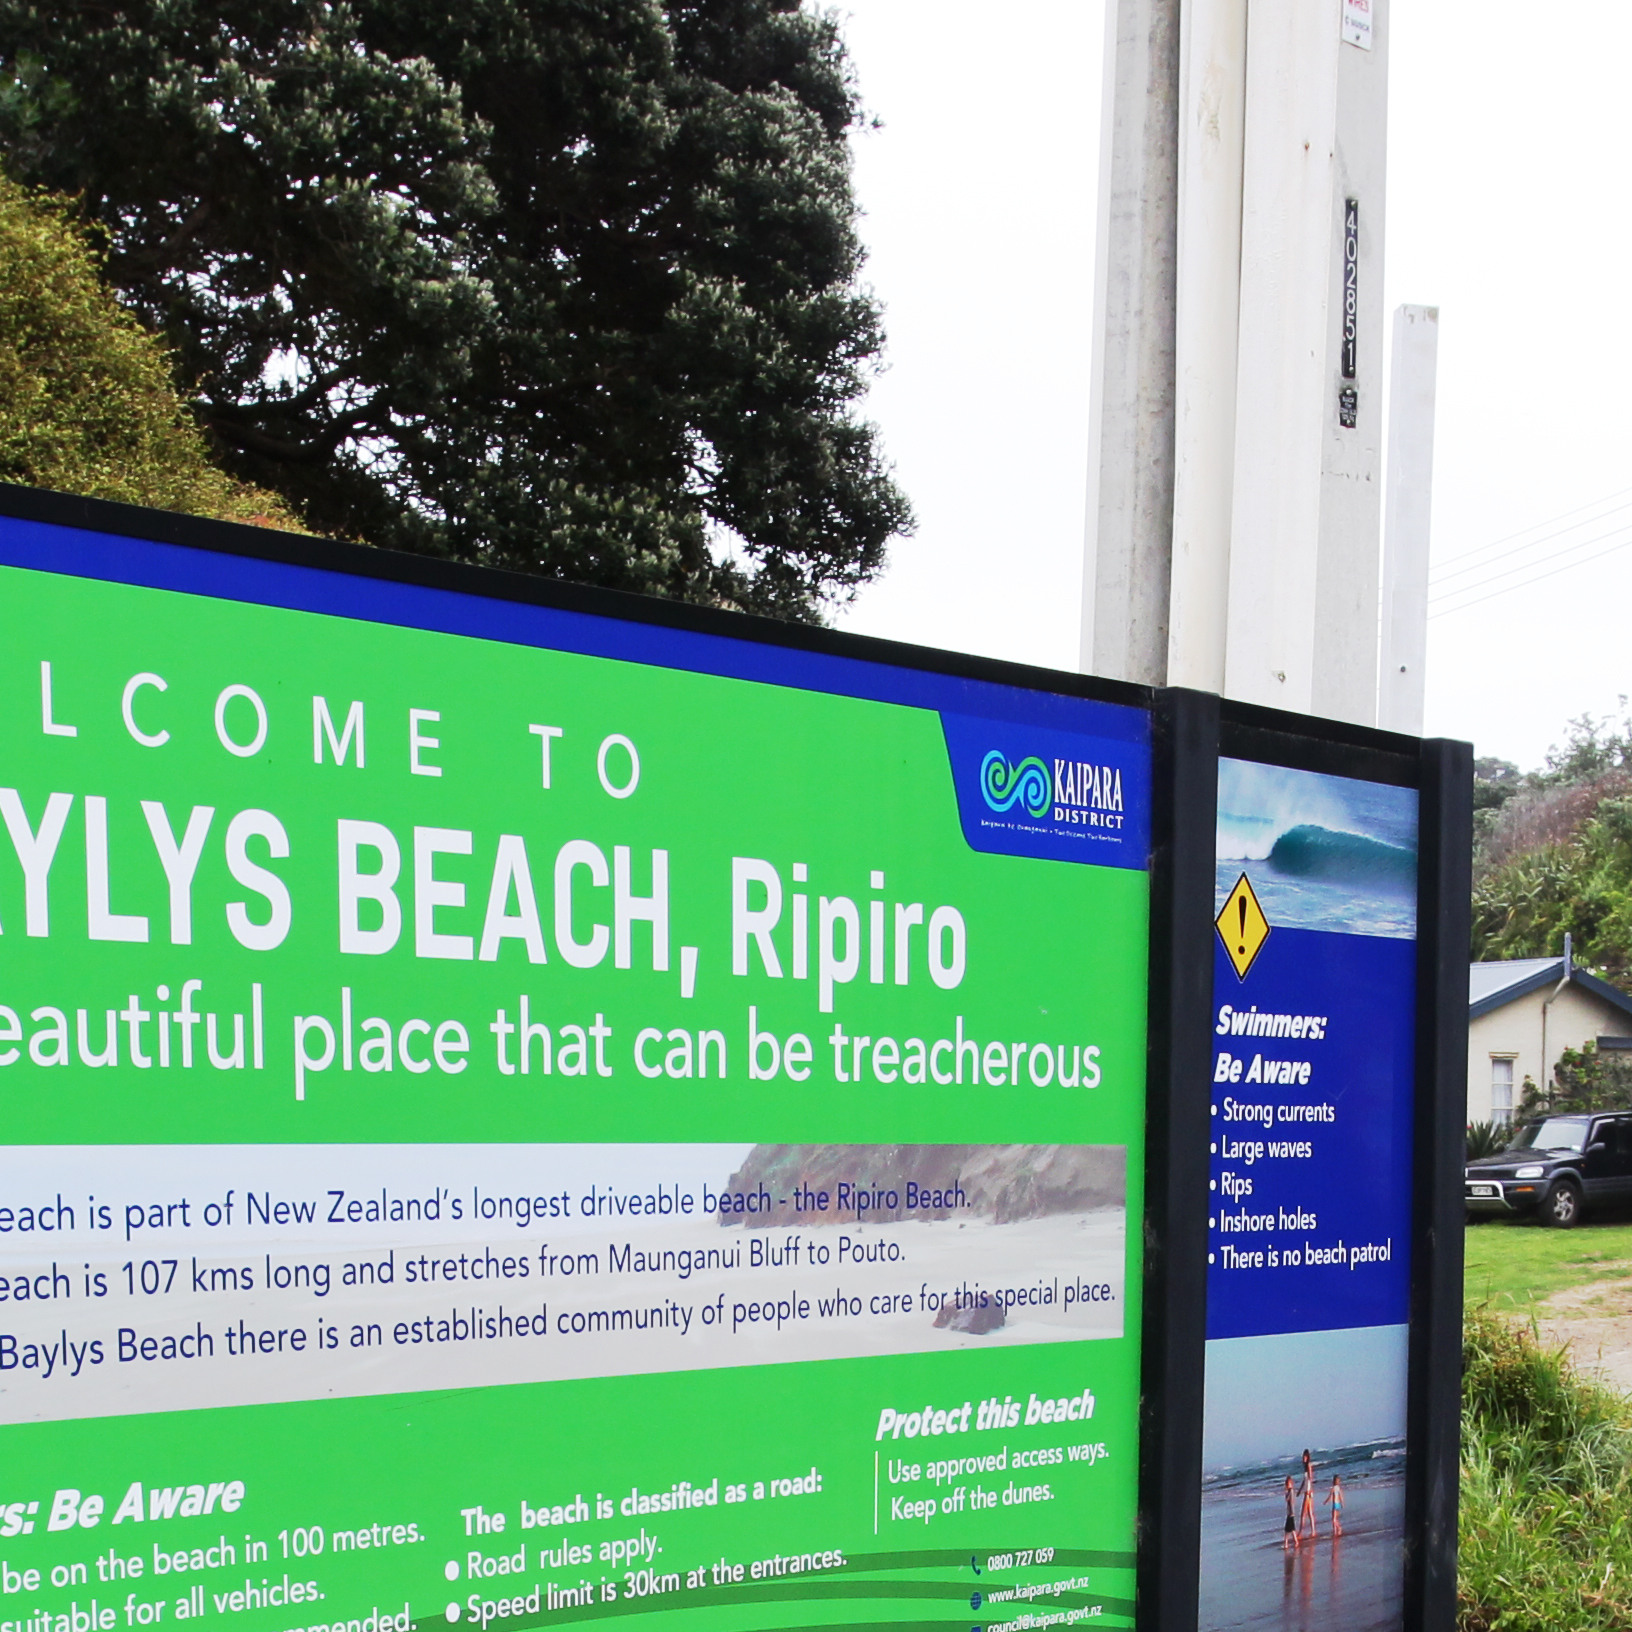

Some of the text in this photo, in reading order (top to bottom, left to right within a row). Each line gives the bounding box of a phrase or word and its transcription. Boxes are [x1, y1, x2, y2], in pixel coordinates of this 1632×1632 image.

[1345, 211, 1356, 366] 402851
[529, 724, 640, 799] TO
[1055, 759, 1122, 811] KAIPARA
[1055, 808, 1123, 831] DISTRICT
[338, 819, 698, 998] BEACH,
[732, 857, 966, 1013] Ripiro
[294, 987, 469, 1100] place
[490, 995, 612, 1077] that
[634, 1028, 726, 1078] can
[749, 1006, 812, 1081] be
[829, 1016, 1100, 1088] treacherous
[1216, 1005, 1327, 1039] Swimmers:
[1214, 1053, 1310, 1084] Be Aware
[1224, 1097, 1334, 1128] Strong currents
[1223, 1135, 1311, 1165] Large waves
[89, 1196, 111, 1229] is
[126, 1199, 190, 1241] part
[204, 1190, 234, 1226] of
[248, 1192, 316, 1224] New
[328, 1187, 462, 1222] Zealand's
[475, 1187, 569, 1227] longest
[581, 1184, 693, 1216] driveable
[704, 1182, 771, 1213] beach
[793, 1181, 829, 1211] the
[838, 1182, 898, 1220] Ripiro
[906, 1179, 970, 1209] Beach.
[1222, 1172, 1252, 1203] Rips
[1221, 1206, 1316, 1232] Inshore holes
[85, 1264, 107, 1296] is
[123, 1260, 177, 1294] 107
[193, 1257, 253, 1291] kms
[267, 1255, 329, 1296] long
[343, 1250, 393, 1285] and
[406, 1247, 529, 1282] stretches
[539, 1244, 598, 1275] from
[610, 1241, 739, 1279] Maunganui
[751, 1236, 800, 1266] Bluff
[808, 1242, 829, 1264] to
[840, 1237, 904, 1262] Pouto.
[1221, 1238, 1390, 1270] There is no beach patrol
[876, 1389, 1095, 1441] Protect this beach
[889, 1443, 1109, 1486] Use approved access ways.
[47, 1489, 104, 1531] Be
[112, 1481, 245, 1524] Aware
[461, 1467, 822, 1535] The beach is classified as a road:
[892, 1481, 1054, 1524] Keep off the dunes.
[2, 1561, 40, 1593] be
[51, 1563, 86, 1587] on
[96, 1549, 143, 1581] the
[154, 1536, 235, 1574] beach
[245, 1535, 267, 1563] in
[278, 1526, 324, 1558] 100
[333, 1523, 425, 1552] metres.
[468, 1528, 662, 1579] Road rules apply.
[988, 1547, 1054, 1571] 0800 727 059
[124, 1594, 165, 1626] for
[175, 1585, 204, 1619] all
[213, 1574, 325, 1613] vehicles.
[468, 1550, 846, 1630] Speed limit is 30km at the entrances.
[988, 1577, 1088, 1603] www.kaipara.govt.nz
